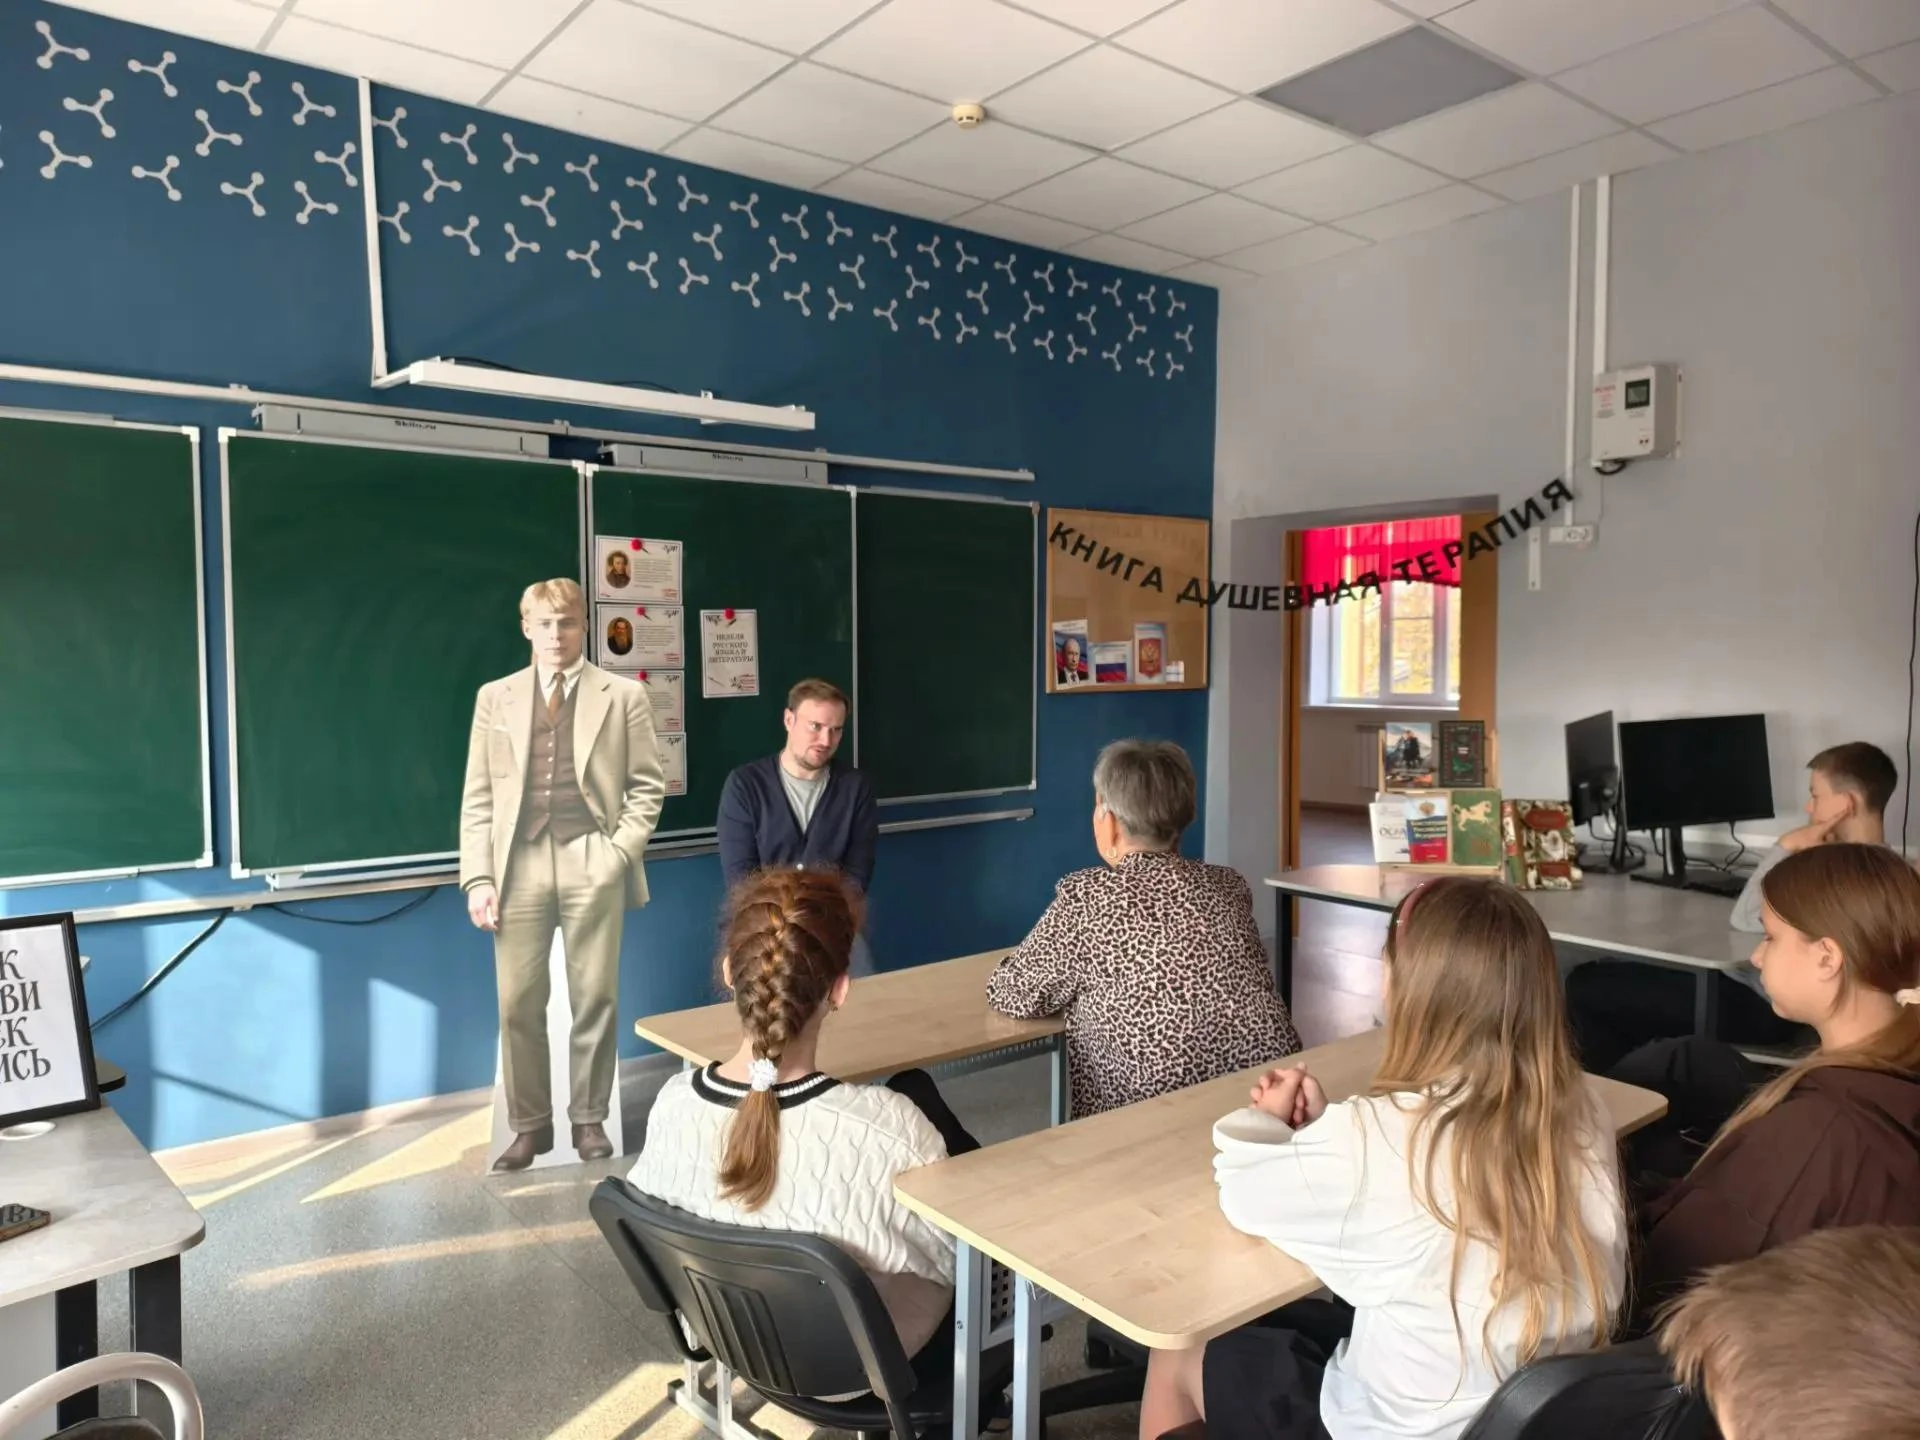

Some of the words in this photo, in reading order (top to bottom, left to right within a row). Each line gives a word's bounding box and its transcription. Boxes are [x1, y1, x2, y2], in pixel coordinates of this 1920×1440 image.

[1049, 521, 1163, 593] КНИГА
[1175, 570, 1382, 612] ДУШЕВНАЯ
[1392, 477, 1575, 585] ТЕРАПИЯ
